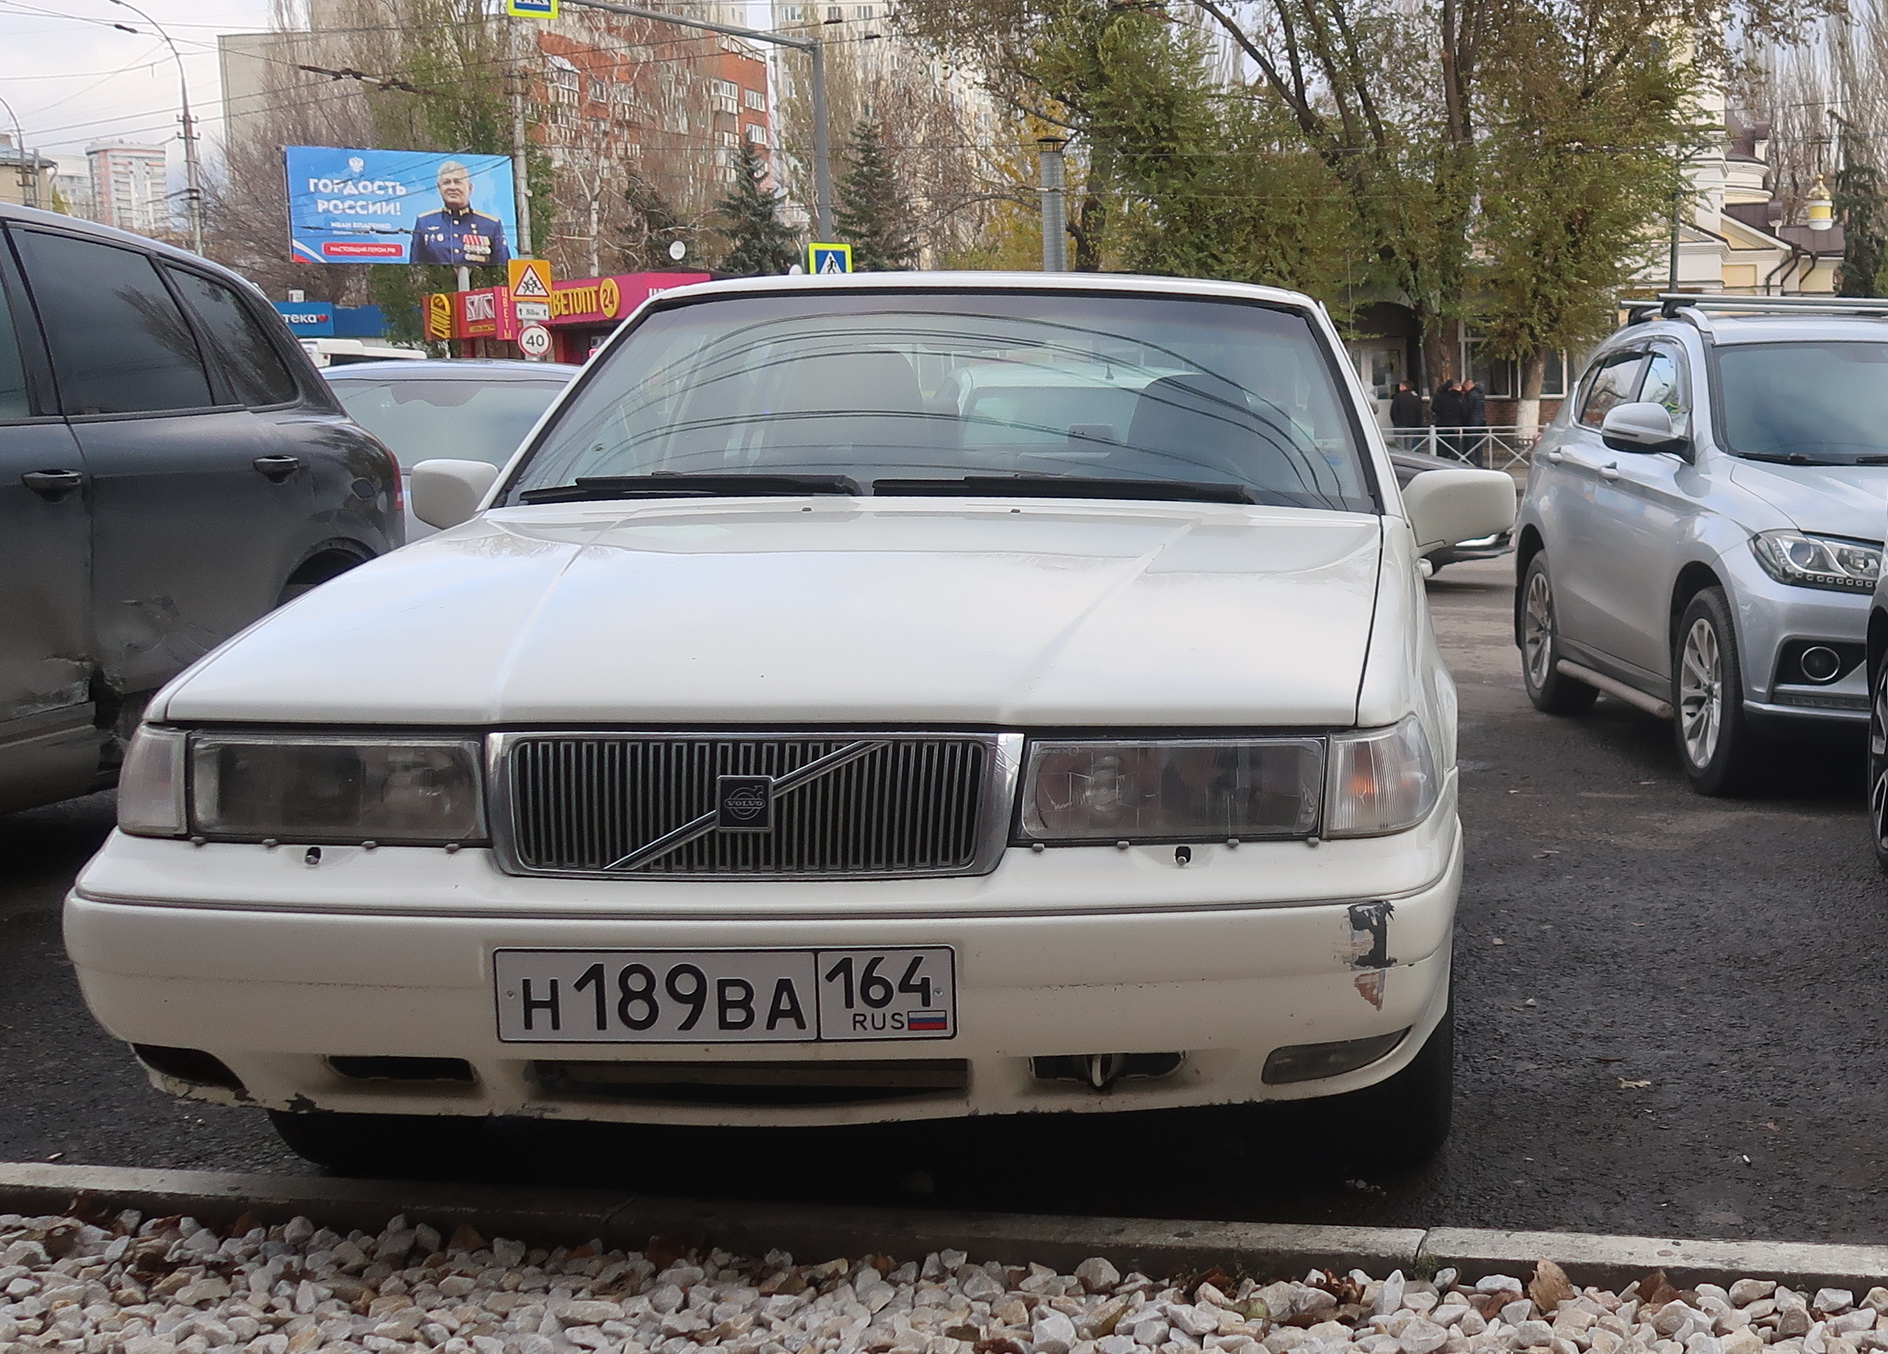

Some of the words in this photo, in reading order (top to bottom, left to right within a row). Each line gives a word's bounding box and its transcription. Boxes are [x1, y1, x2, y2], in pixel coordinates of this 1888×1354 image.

[308, 178, 406, 195] ГОРДОСТЬ
[317, 199, 401, 216] РОССИИ!
[549, 286, 599, 319] ВЕТОПТ
[602, 288, 615, 309] 24
[281, 313, 317, 324] тека
[501, 287, 512, 339] ЦВЕТЫ
[526, 334, 545, 347] 40
[824, 955, 933, 1010] 164
[852, 1013, 905, 1032] RUS
